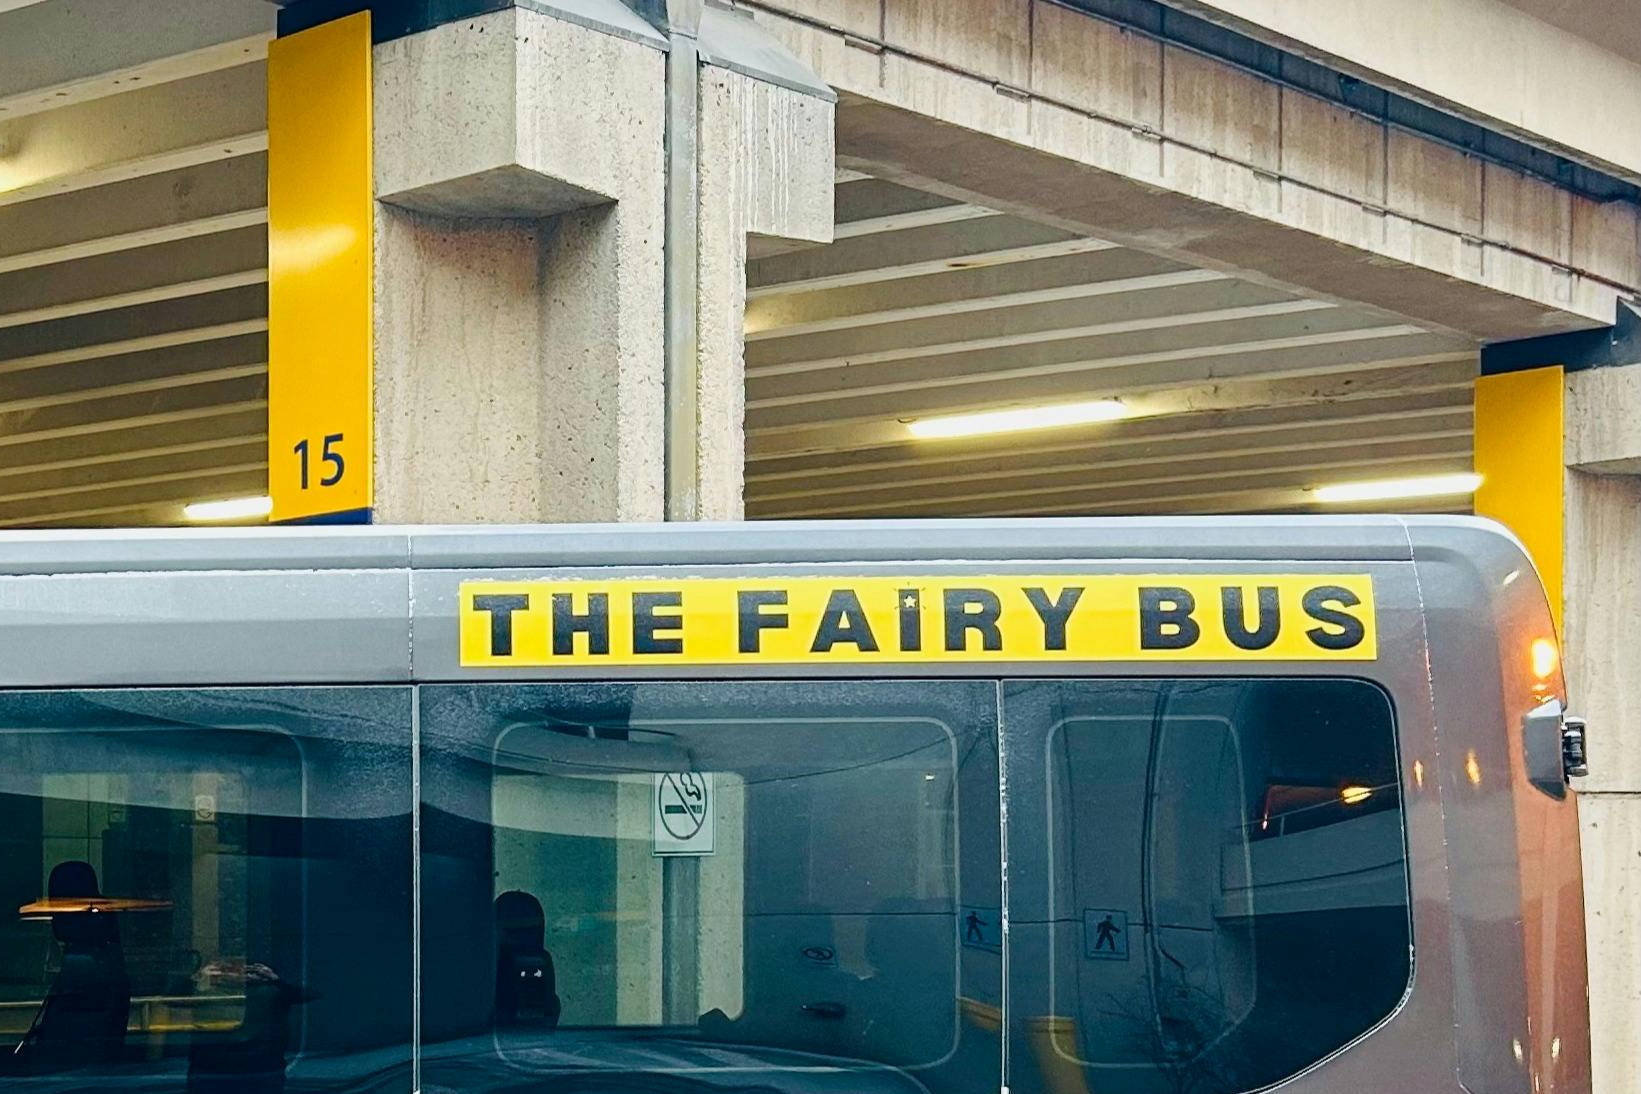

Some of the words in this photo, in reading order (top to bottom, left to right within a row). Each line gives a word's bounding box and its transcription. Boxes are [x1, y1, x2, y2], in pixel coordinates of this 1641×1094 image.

[294, 432, 345, 490] 15
[472, 591, 684, 656] THE
[738, 587, 1084, 654] FAIRY
[1139, 584, 1366, 651] BUS
